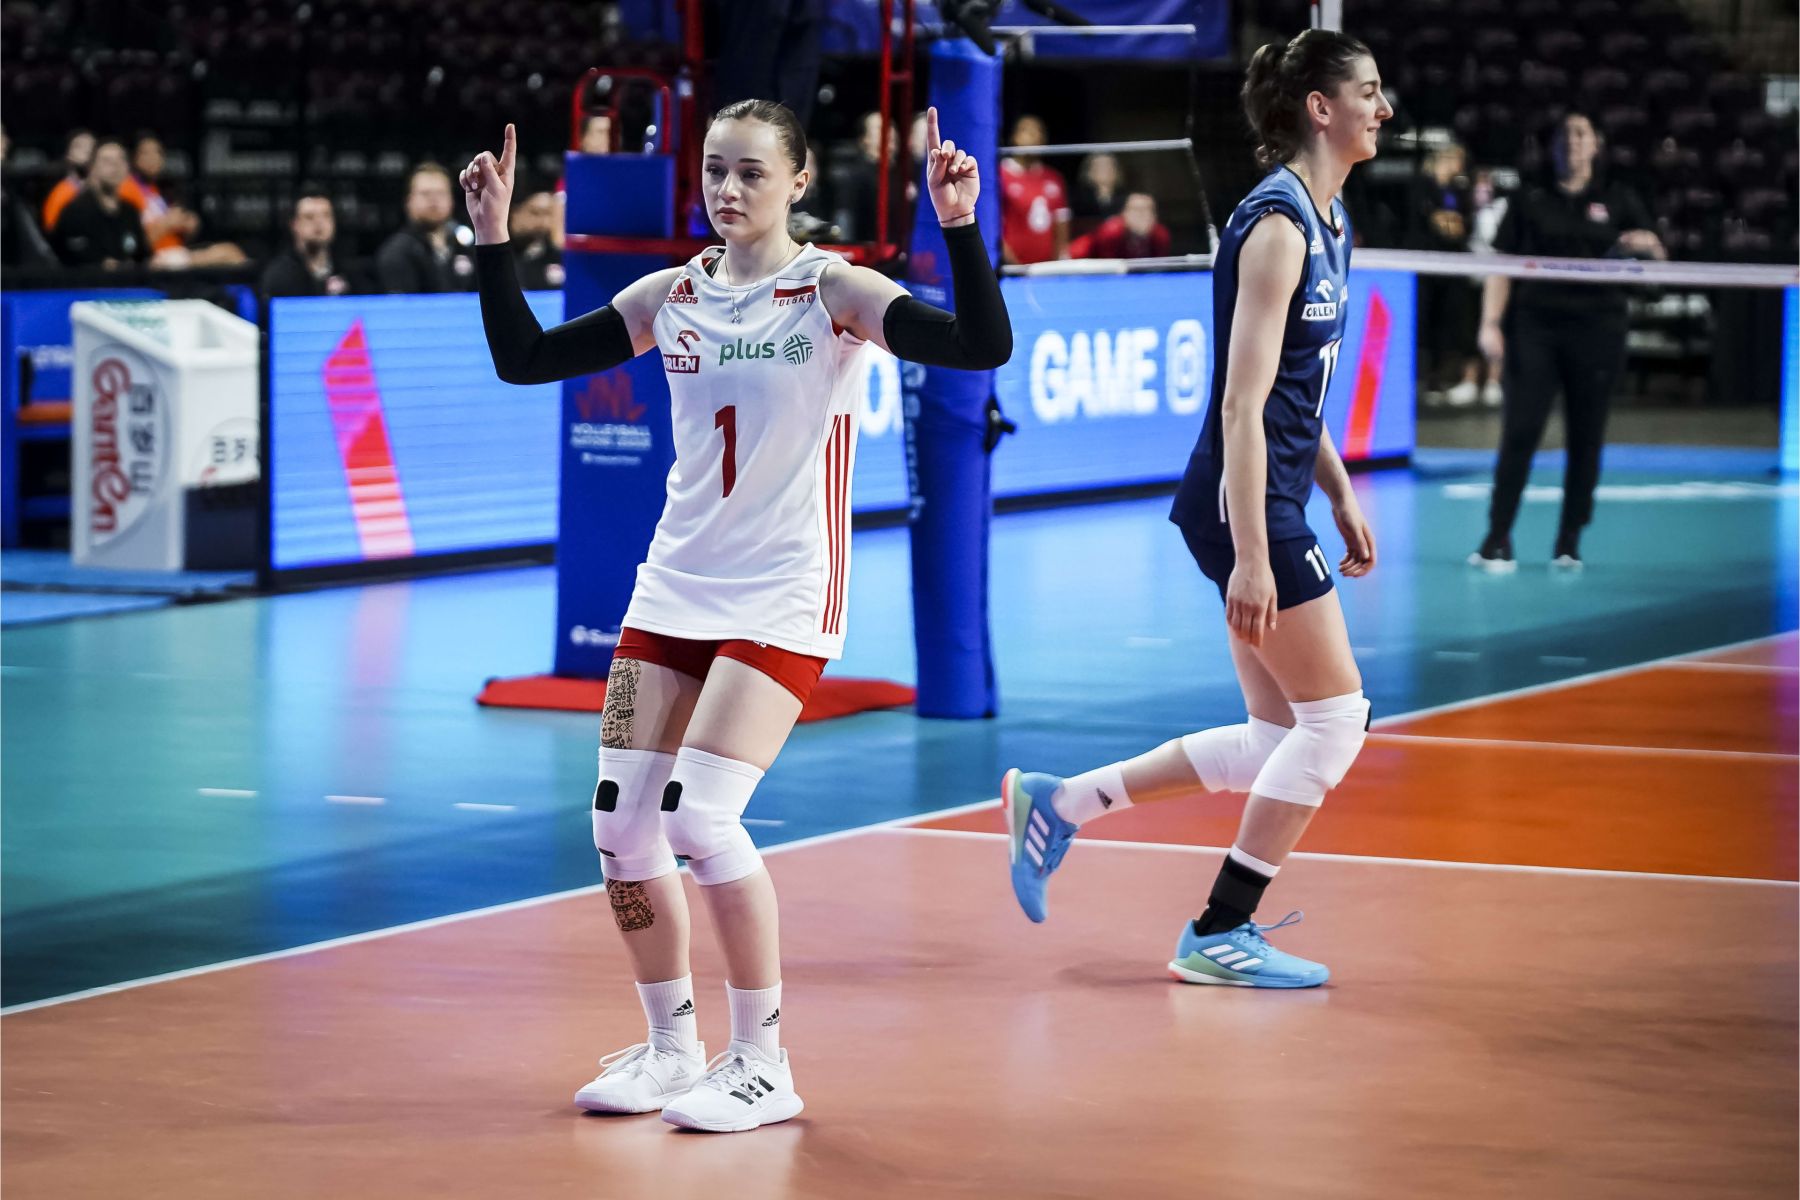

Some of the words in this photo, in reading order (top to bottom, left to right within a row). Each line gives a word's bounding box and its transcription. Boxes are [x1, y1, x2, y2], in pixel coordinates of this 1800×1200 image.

[666, 294, 698, 305] adidas
[1306, 303, 1335, 318] ORLEN
[718, 337, 776, 366] plus
[1030, 328, 1159, 423] GAME
[715, 404, 737, 499] 1
[1304, 543, 1331, 582] 11
